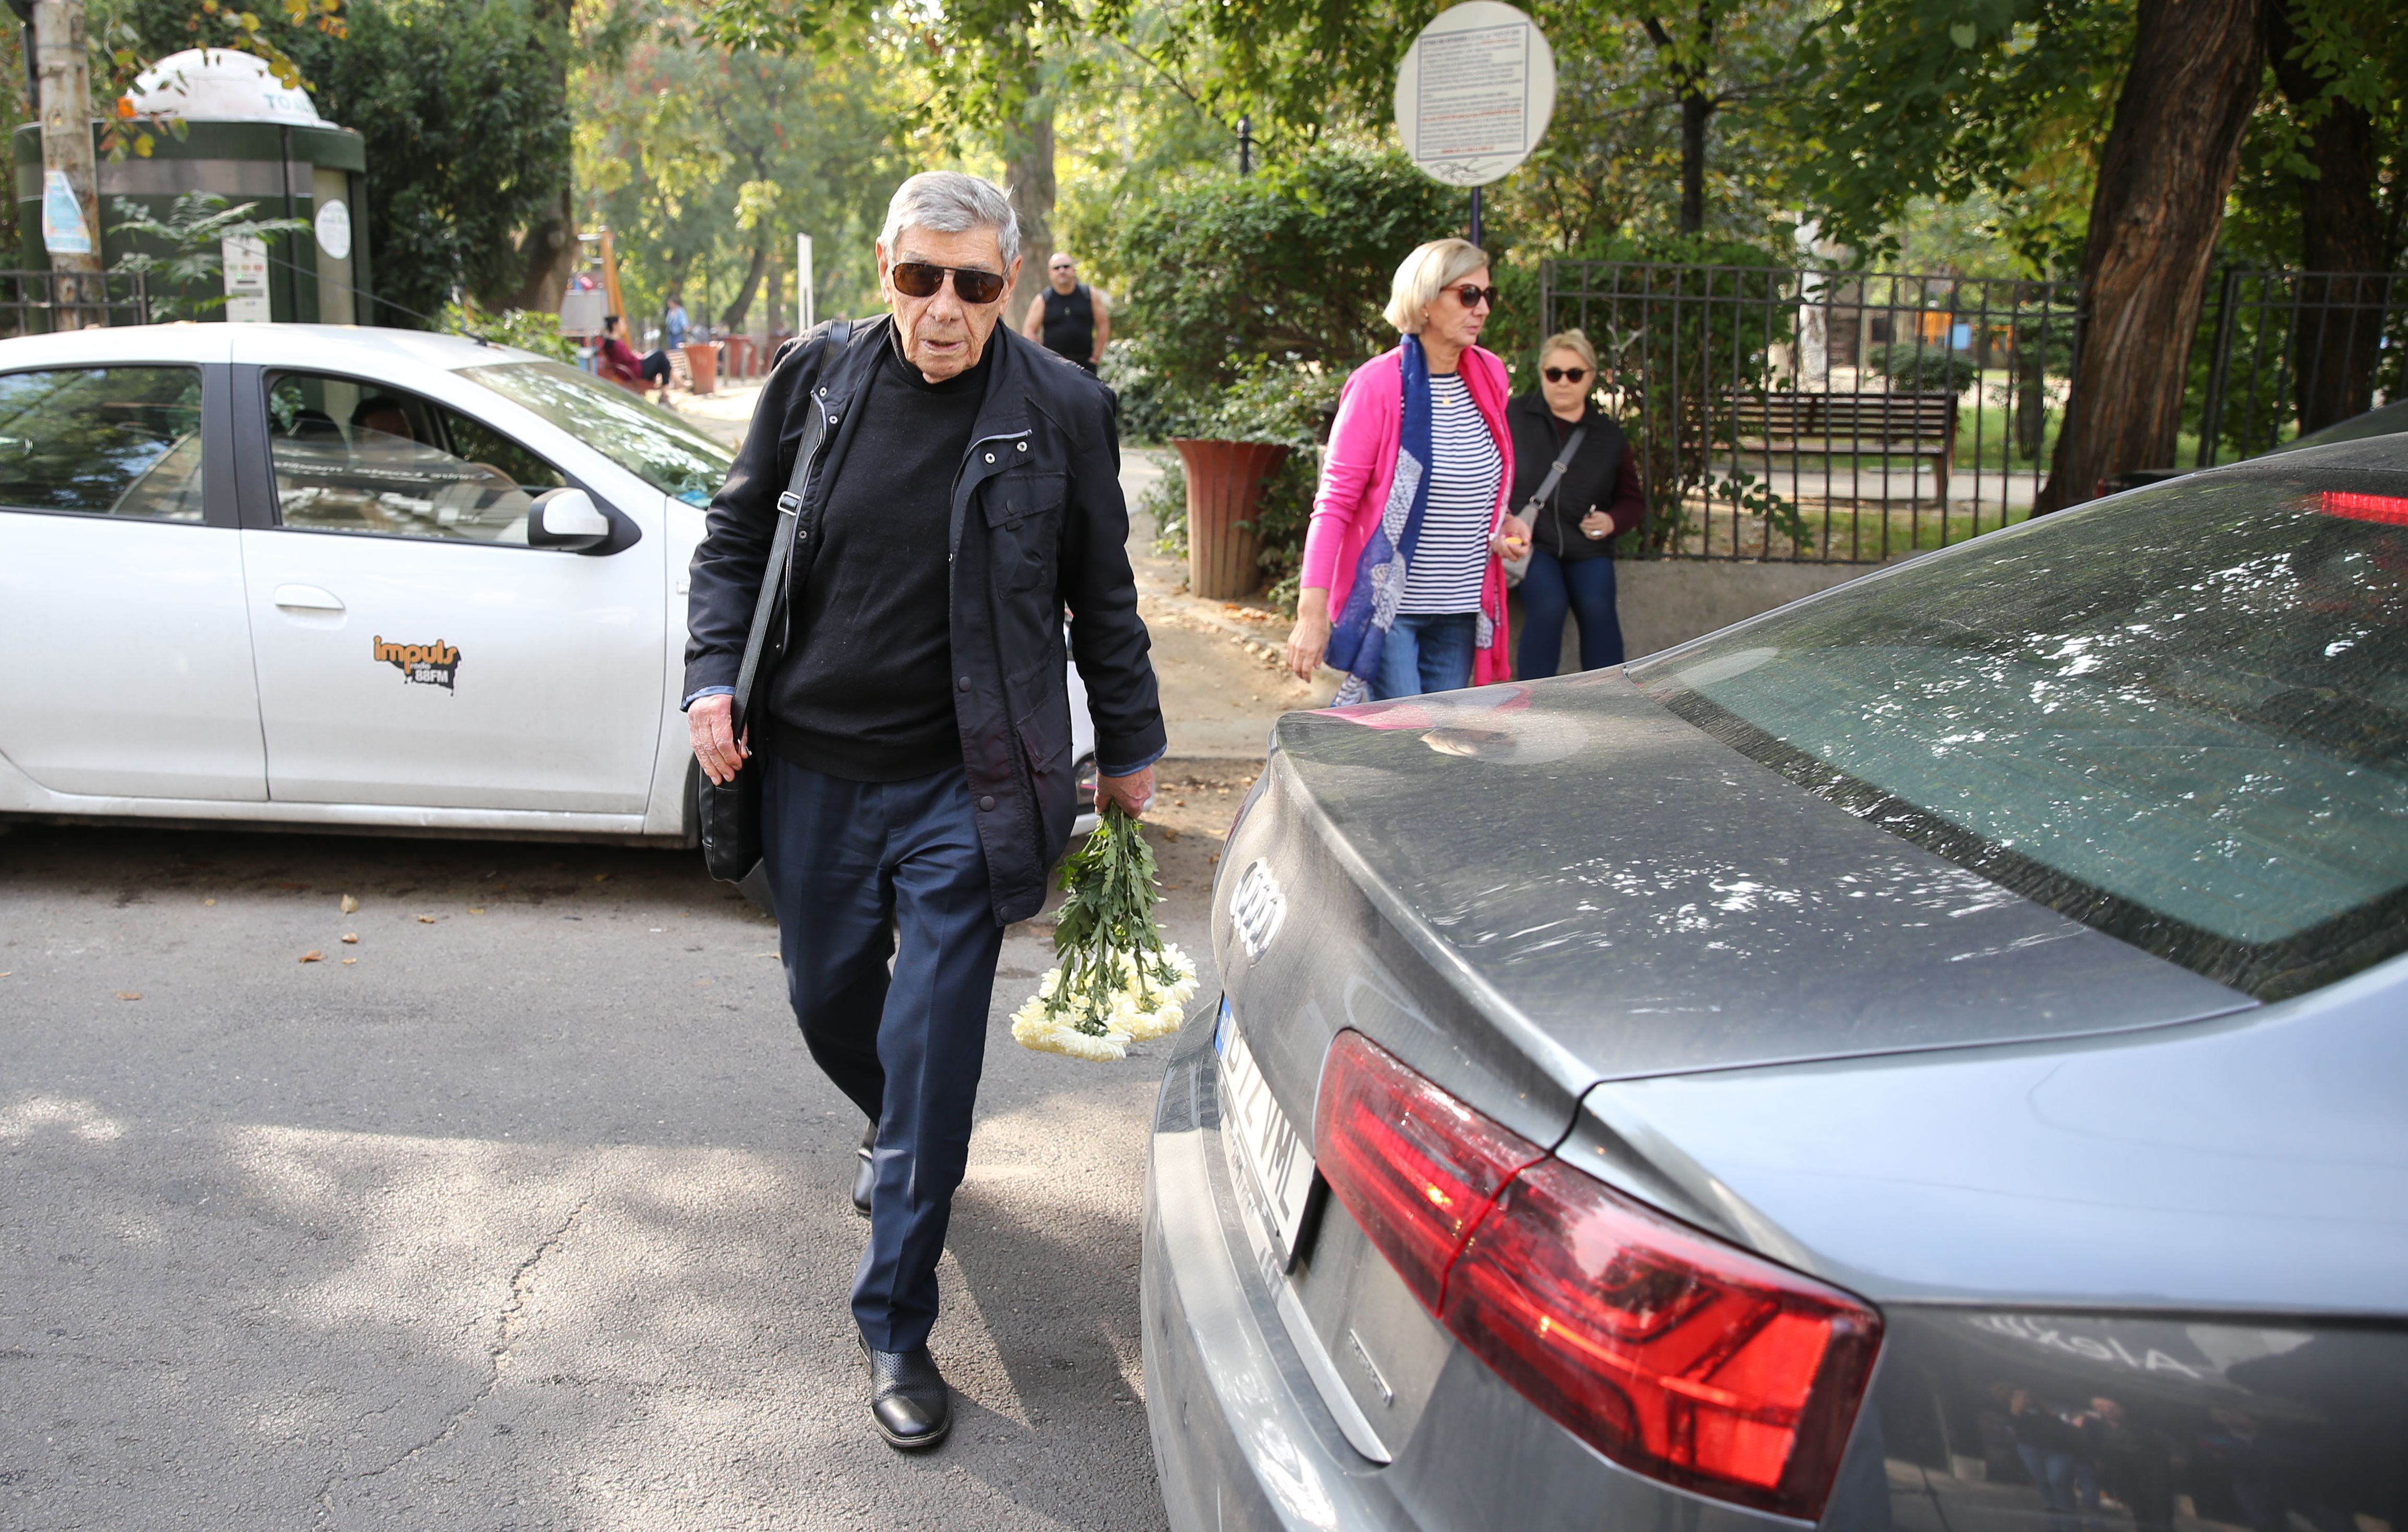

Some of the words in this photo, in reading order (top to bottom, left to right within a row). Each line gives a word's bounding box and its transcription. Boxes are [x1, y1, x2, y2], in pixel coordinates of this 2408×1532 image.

[374, 636, 457, 674] impuls
[415, 669, 449, 683] 88FM
[1219, 1009, 1229, 1044] RO
